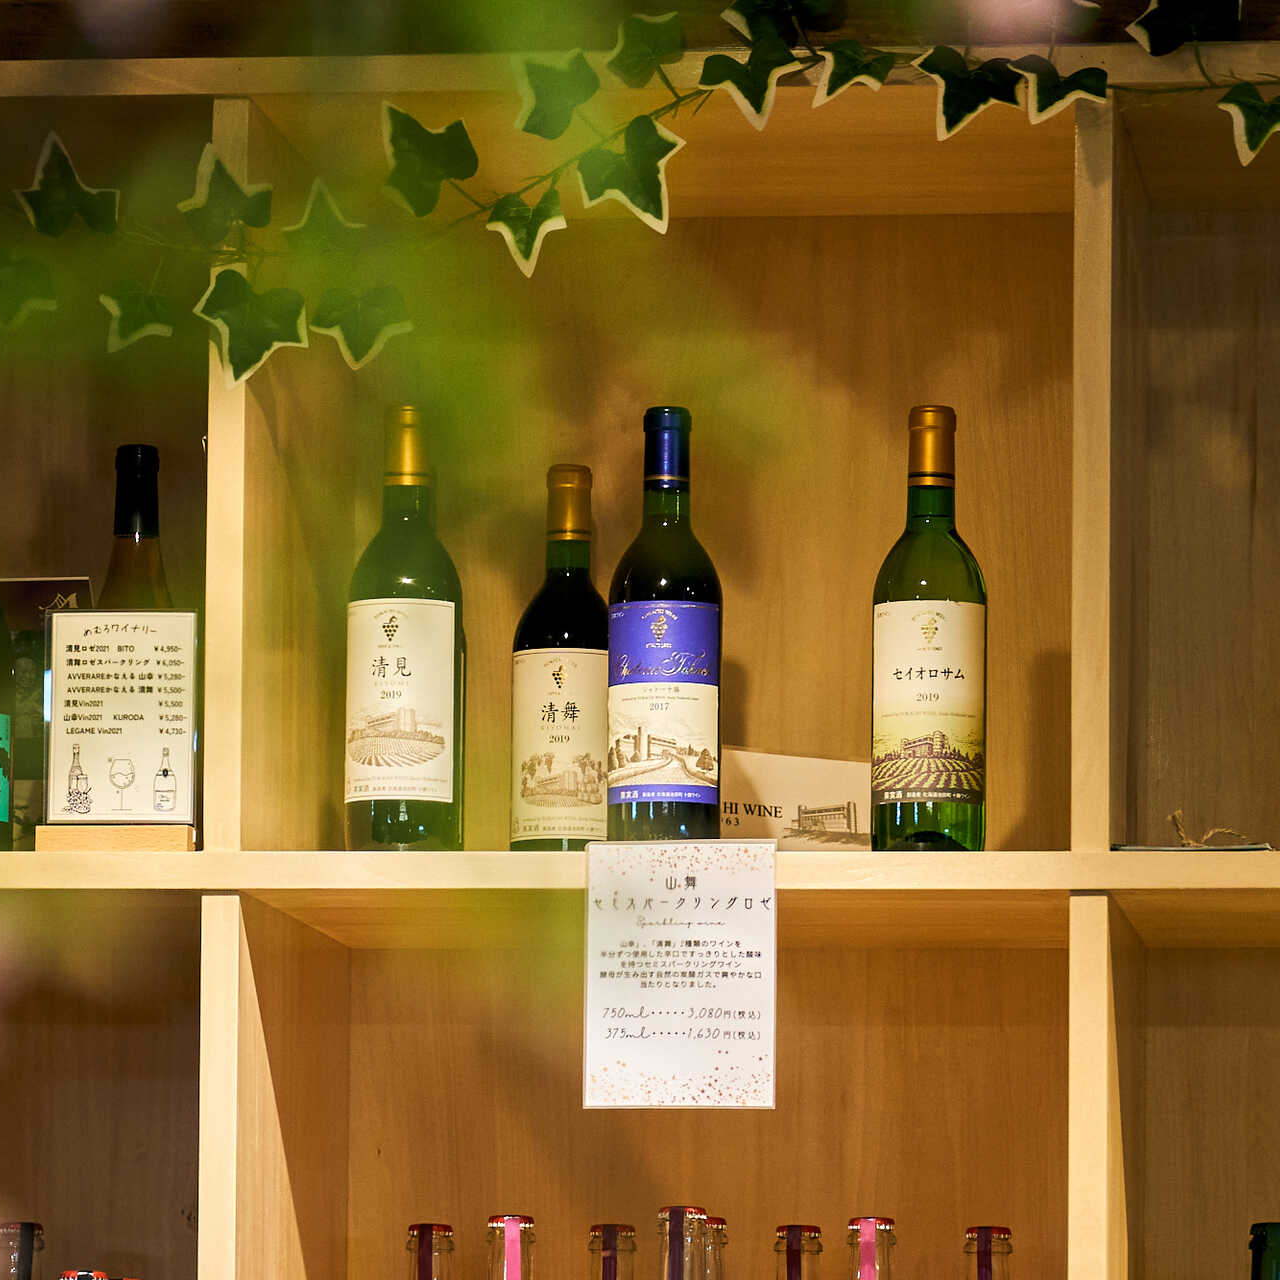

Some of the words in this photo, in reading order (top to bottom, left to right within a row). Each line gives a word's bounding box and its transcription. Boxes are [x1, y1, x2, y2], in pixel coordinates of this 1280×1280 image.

[372, 656, 412, 678] 清見
[893, 667, 965, 680] セイオロサム
[380, 690, 402, 699] 2019
[916, 693, 939, 702] 2019
[541, 701, 580, 723] 清舞
[649, 703, 670, 711] 2017
[549, 735, 570, 743] 2019
[743, 803, 783, 818] WINE
[666, 876, 697, 890] 山舞
[594, 896, 773, 911] セミスパークリングロゼ
